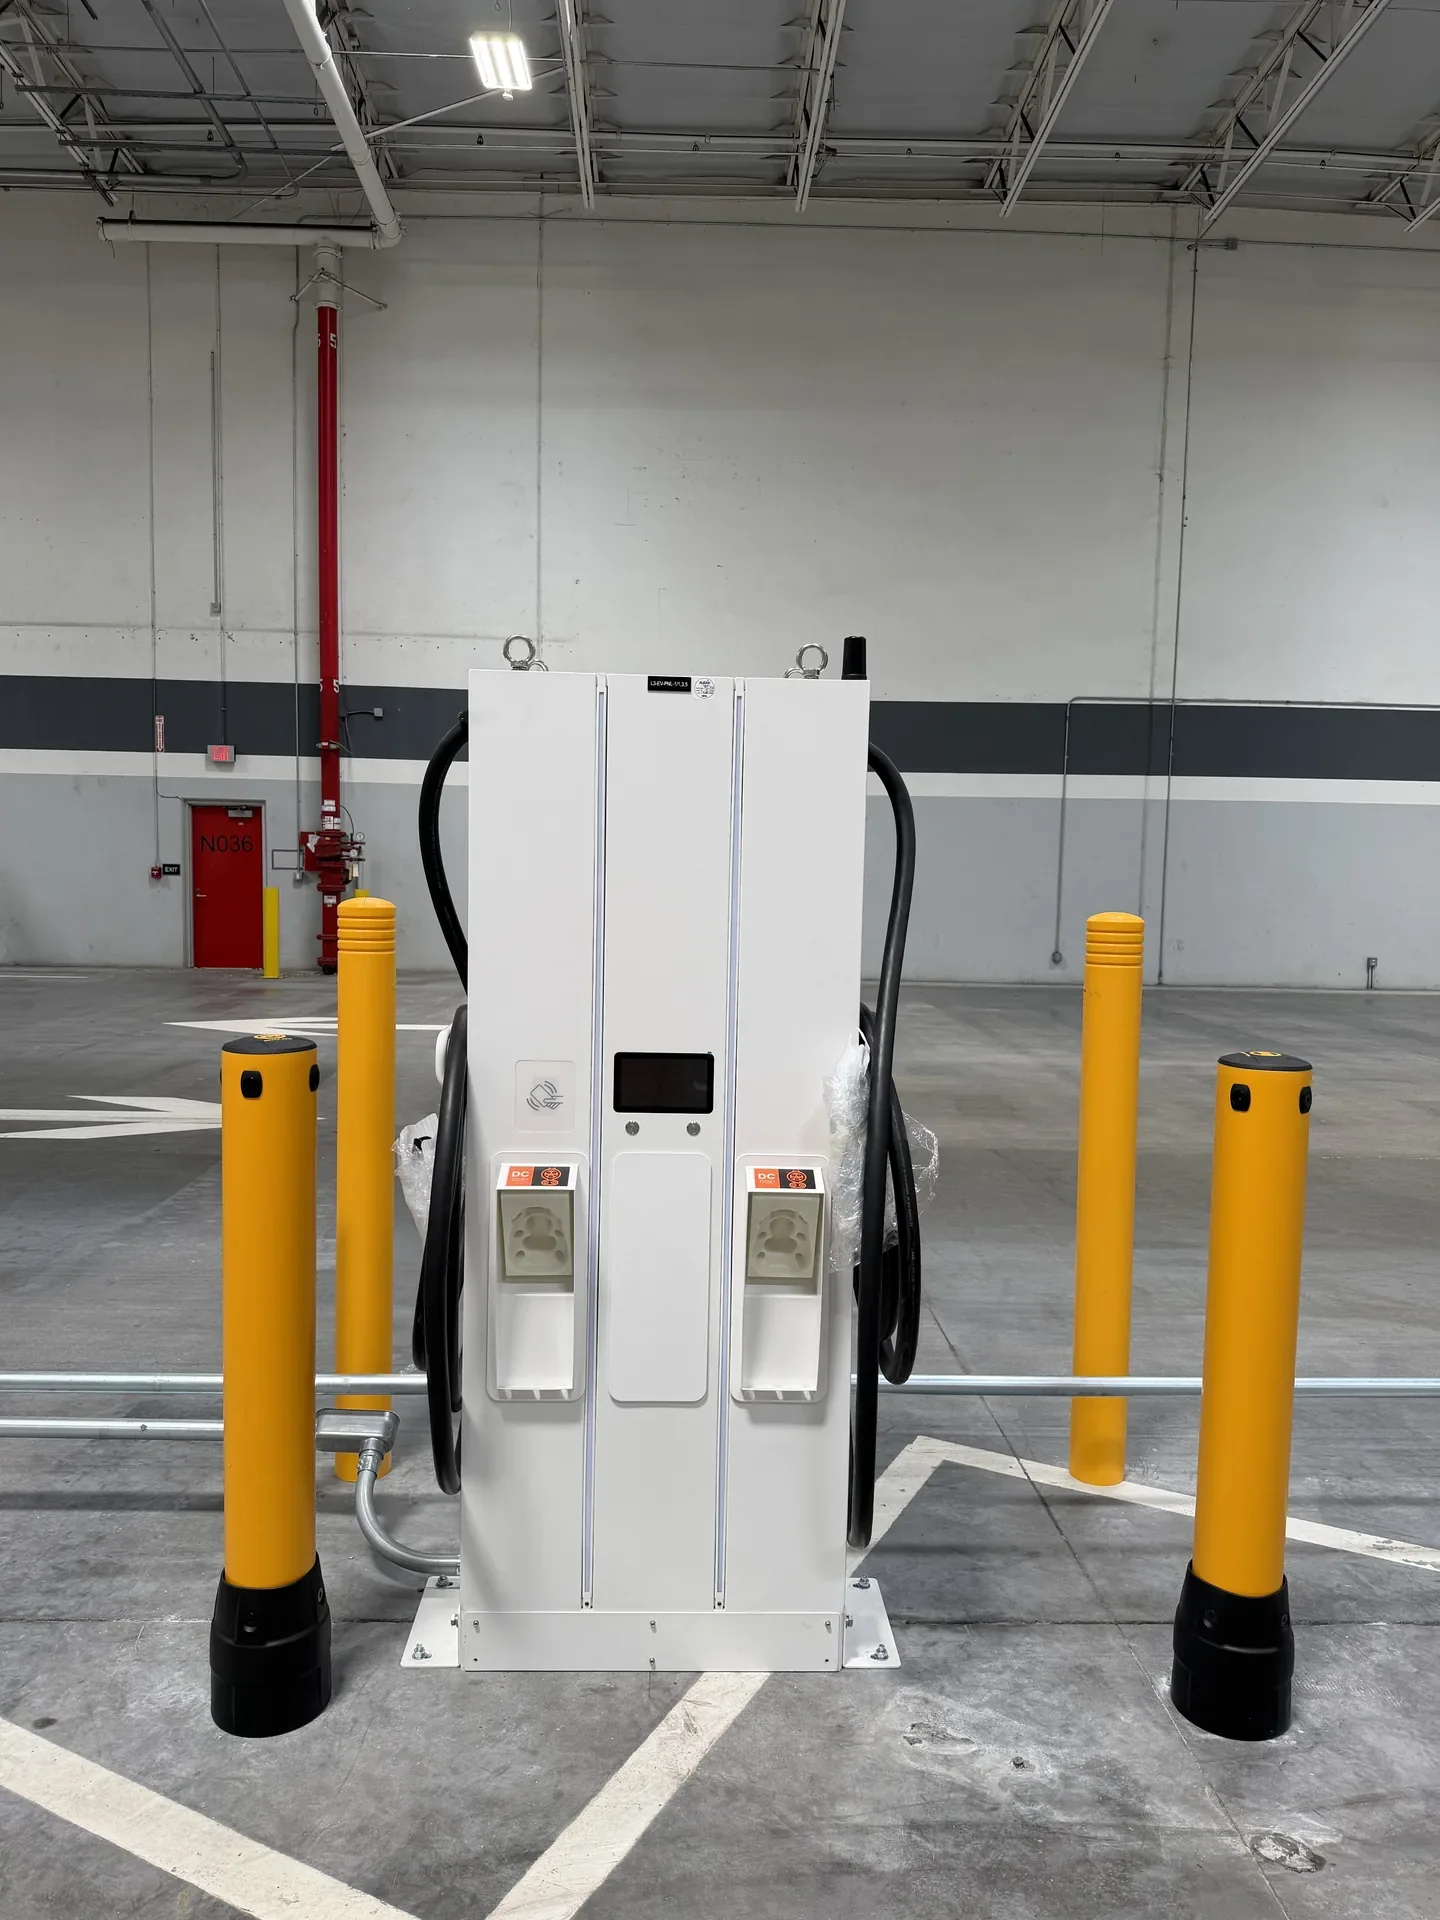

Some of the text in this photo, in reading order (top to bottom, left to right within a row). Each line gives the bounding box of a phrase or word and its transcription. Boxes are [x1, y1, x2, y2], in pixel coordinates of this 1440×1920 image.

[333, 679, 340, 693] 5
[211, 746, 230, 760] EXIT
[201, 834, 253, 852] N036
